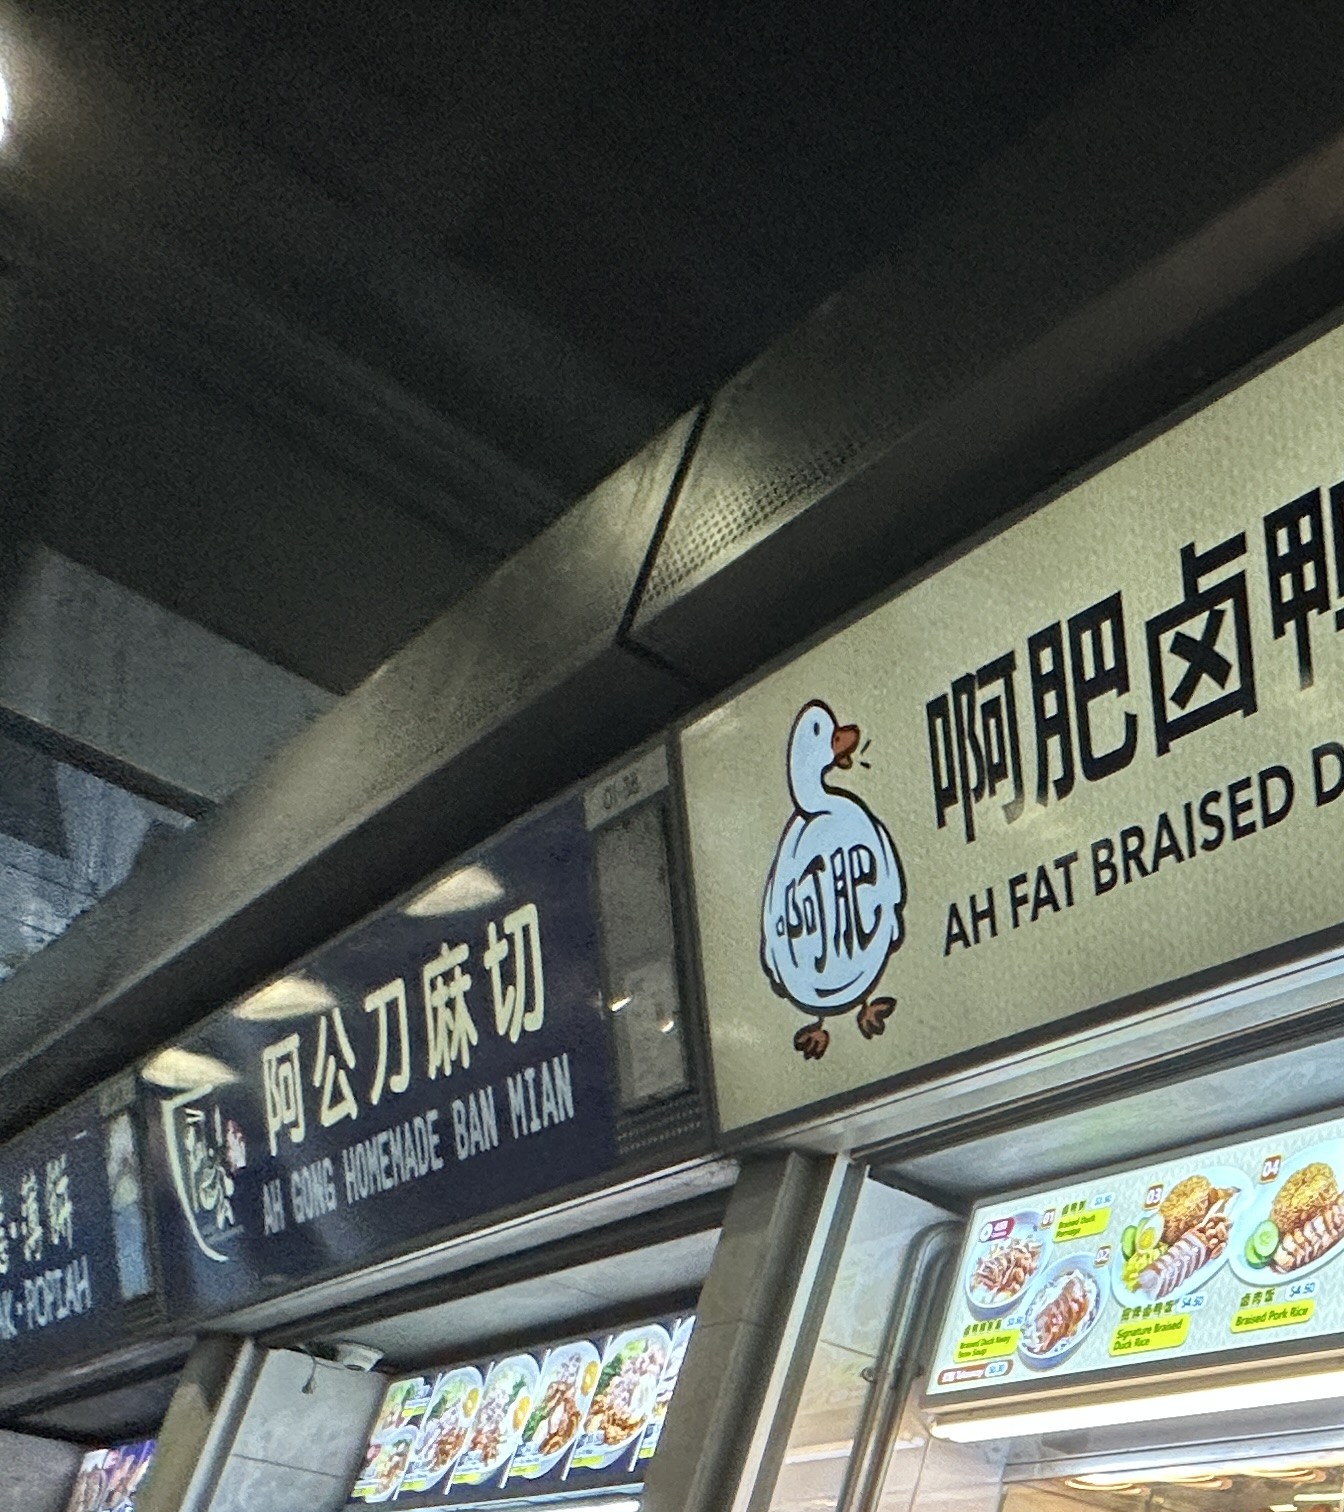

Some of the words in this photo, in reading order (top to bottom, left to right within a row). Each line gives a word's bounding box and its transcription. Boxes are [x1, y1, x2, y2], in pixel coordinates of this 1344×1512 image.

[944, 888, 998, 957] AH
[1008, 851, 1080, 930] FAT
[1090, 764, 1296, 897] BRAISED
[262, 902, 545, 1156] 阿公刀麻切
[263, 1179, 286, 1237] AH
[342, 1108, 445, 1204] HOMEMADE
[452, 1085, 499, 1161] BAN
[506, 1052, 575, 1140] MIAN
[1262, 1159, 1280, 1178] 04
[1146, 1187, 1163, 1206] 03
[1235, 1311, 1267, 1327] Braised
[1268, 1308, 1288, 1321] Pork
[1290, 1306, 1309, 1317] Rice
[1116, 1326, 1153, 1341] Signature
[1153, 1319, 1184, 1333] Braised
[1113, 1341, 1132, 1351] Duck
